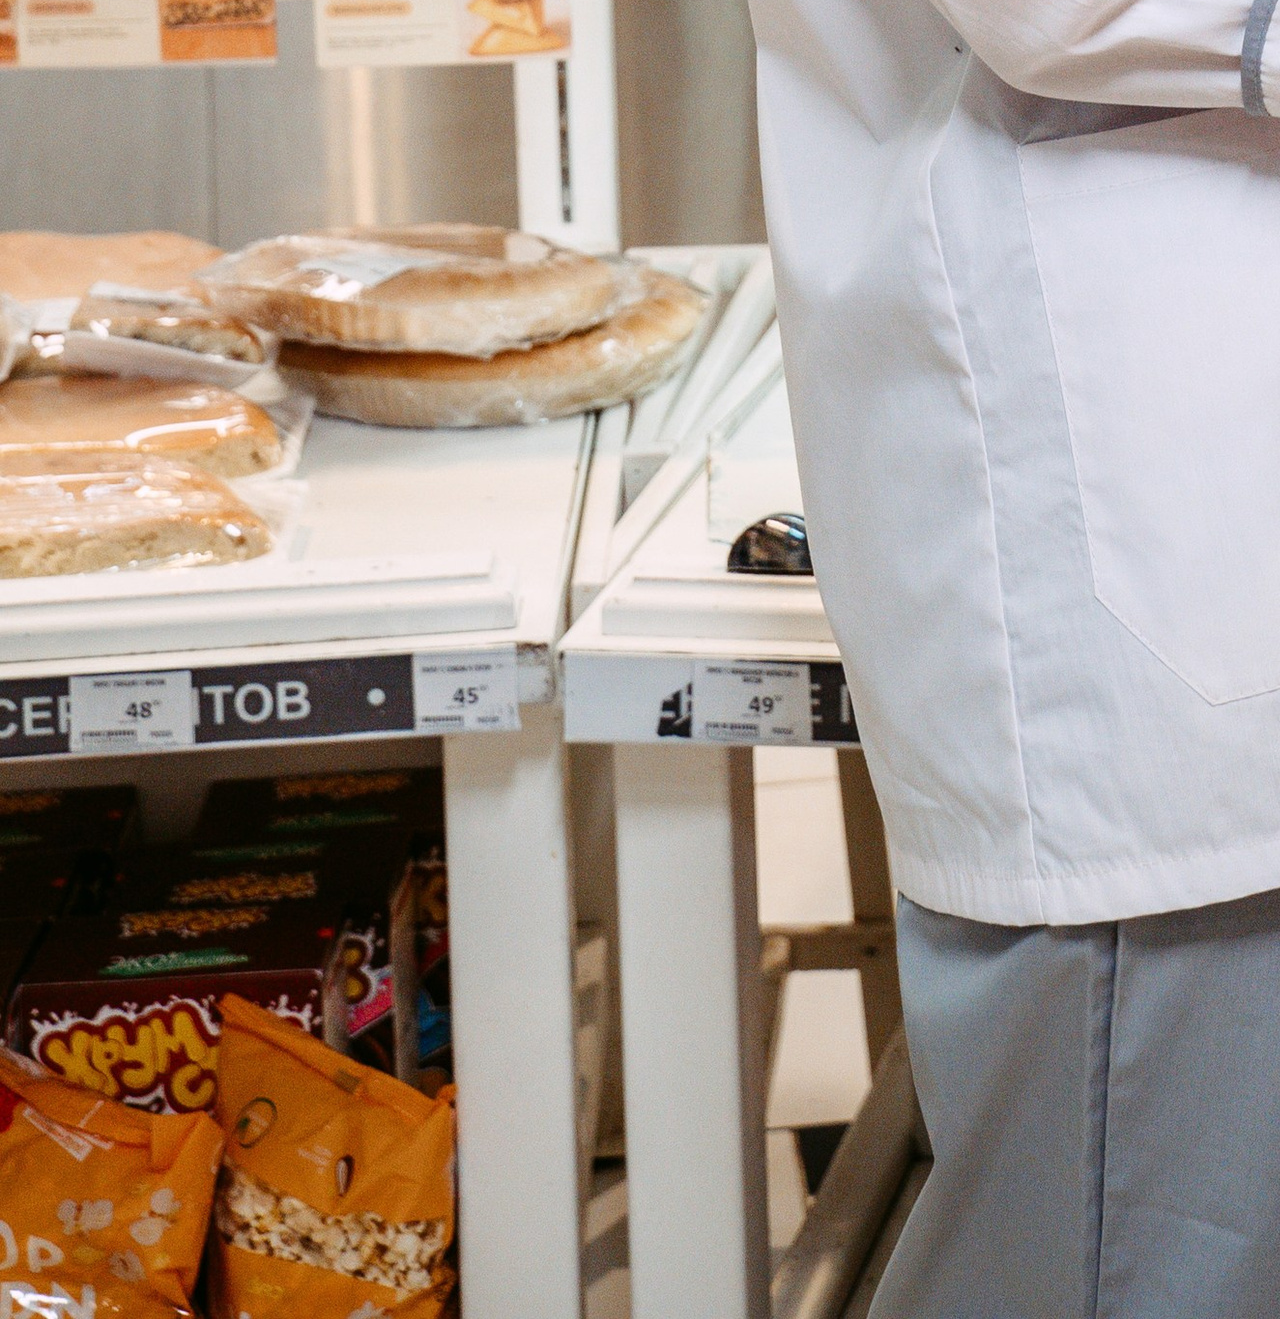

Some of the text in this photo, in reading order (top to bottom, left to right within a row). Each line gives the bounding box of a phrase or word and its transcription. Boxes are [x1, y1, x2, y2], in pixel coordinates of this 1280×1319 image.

[453, 687, 479, 704] 45
[748, 695, 775, 714] 49
[125, 701, 152, 719] 48
